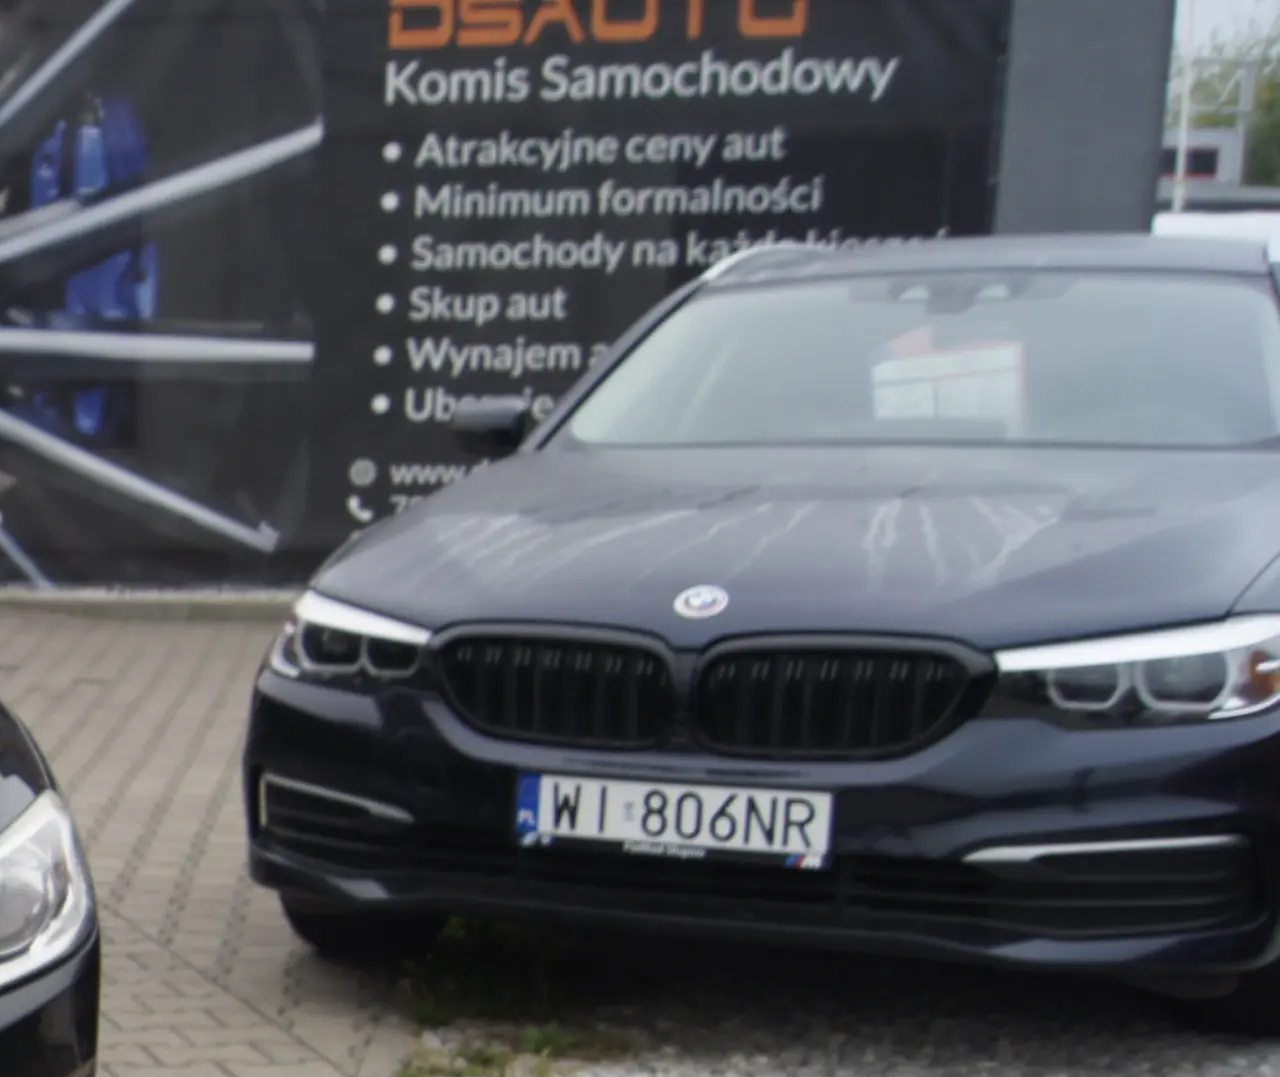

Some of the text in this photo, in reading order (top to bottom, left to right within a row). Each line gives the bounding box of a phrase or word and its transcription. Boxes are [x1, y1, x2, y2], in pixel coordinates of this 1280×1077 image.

[384, 47, 899, 105] Komis Samochodowy
[414, 125, 785, 171] Atrakcyjne ceny aut
[414, 174, 824, 219] Minimum formalności
[411, 232, 626, 272] Samochody
[632, 237, 679, 268] na
[408, 285, 568, 327] Skup aut
[406, 334, 582, 378] Wynajem
[553, 781, 817, 849] WI 806NR
